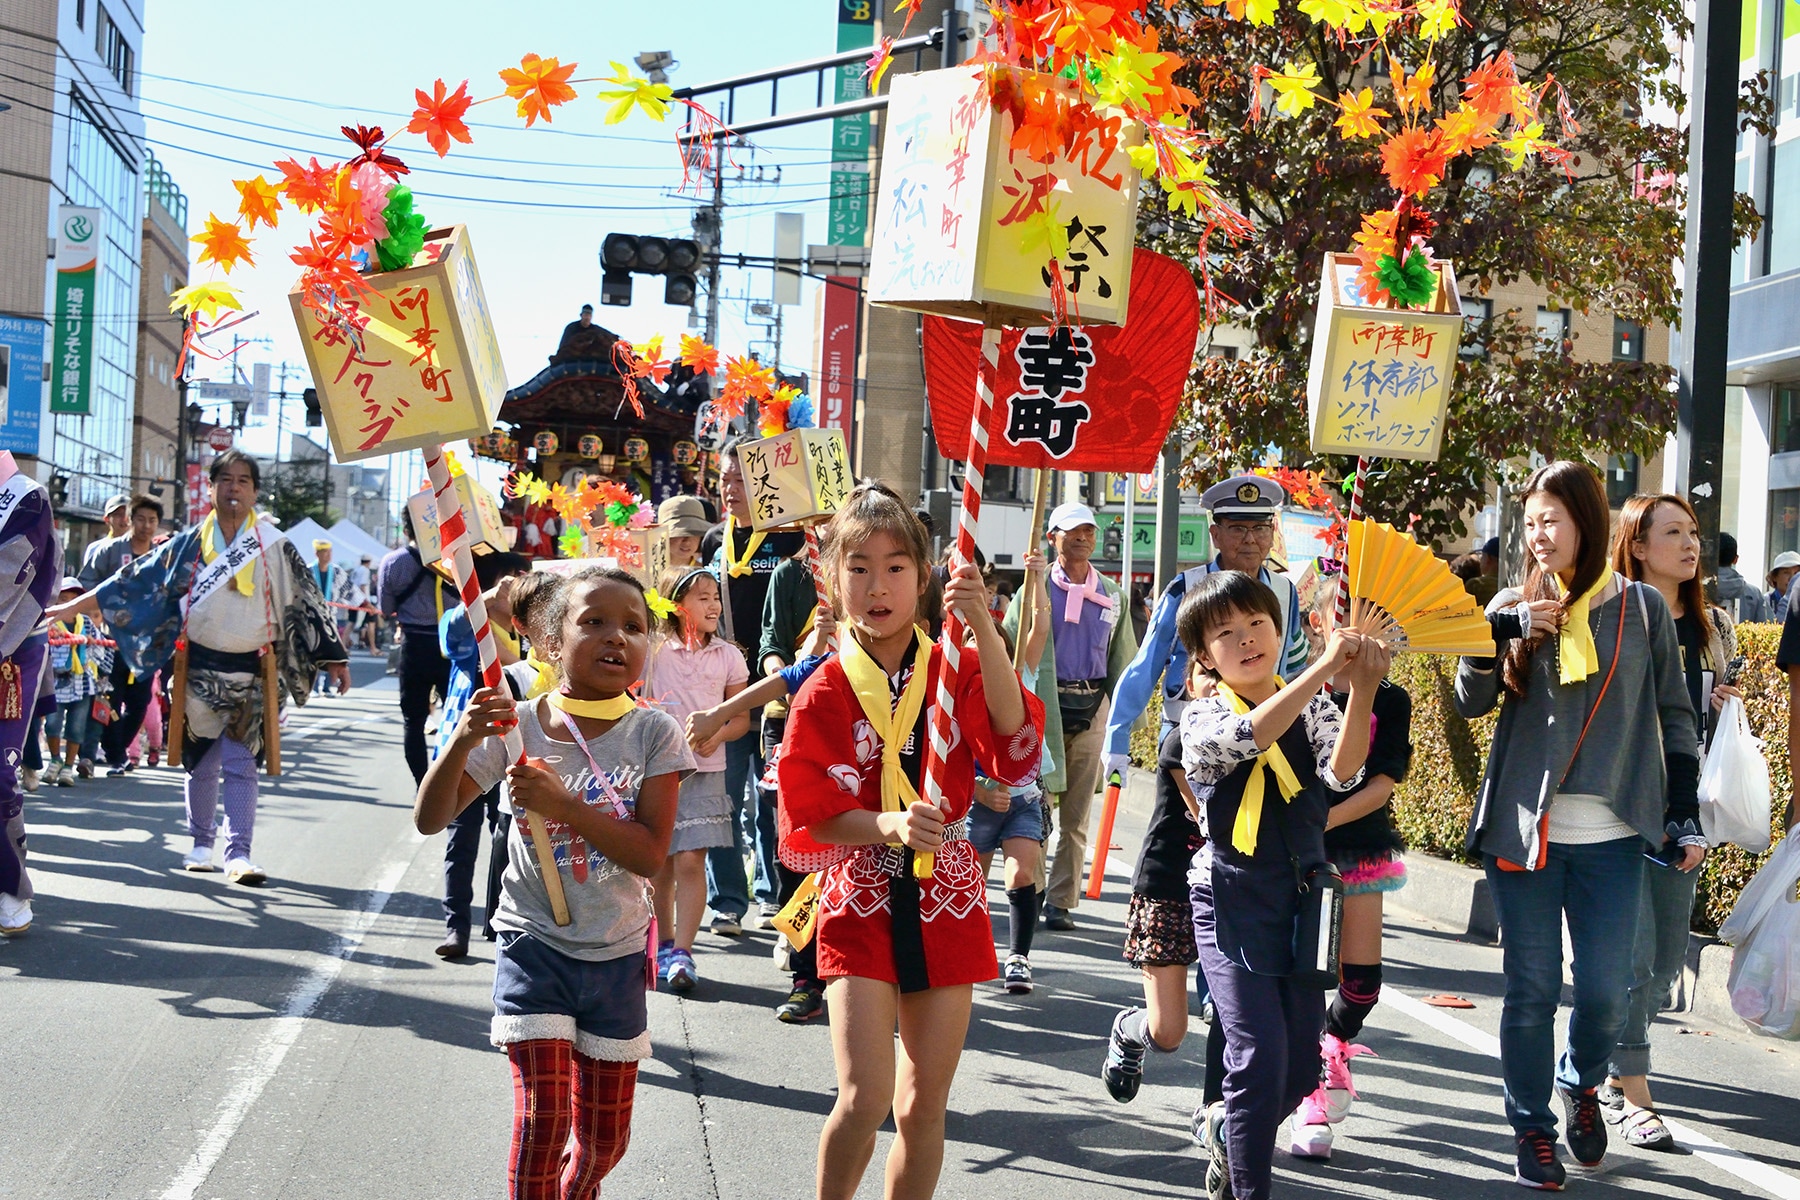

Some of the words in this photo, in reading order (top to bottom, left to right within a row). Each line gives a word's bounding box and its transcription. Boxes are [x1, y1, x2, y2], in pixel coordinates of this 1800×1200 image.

[61, 287, 84, 404] 埼玉りそな銀行
[1352, 322, 1438, 360] 御幸町
[1342, 358, 1439, 405] 体育部
[1336, 397, 1382, 422] ソフト
[774, 441, 799, 469] 祝
[745, 446, 785, 520] 所沢祭
